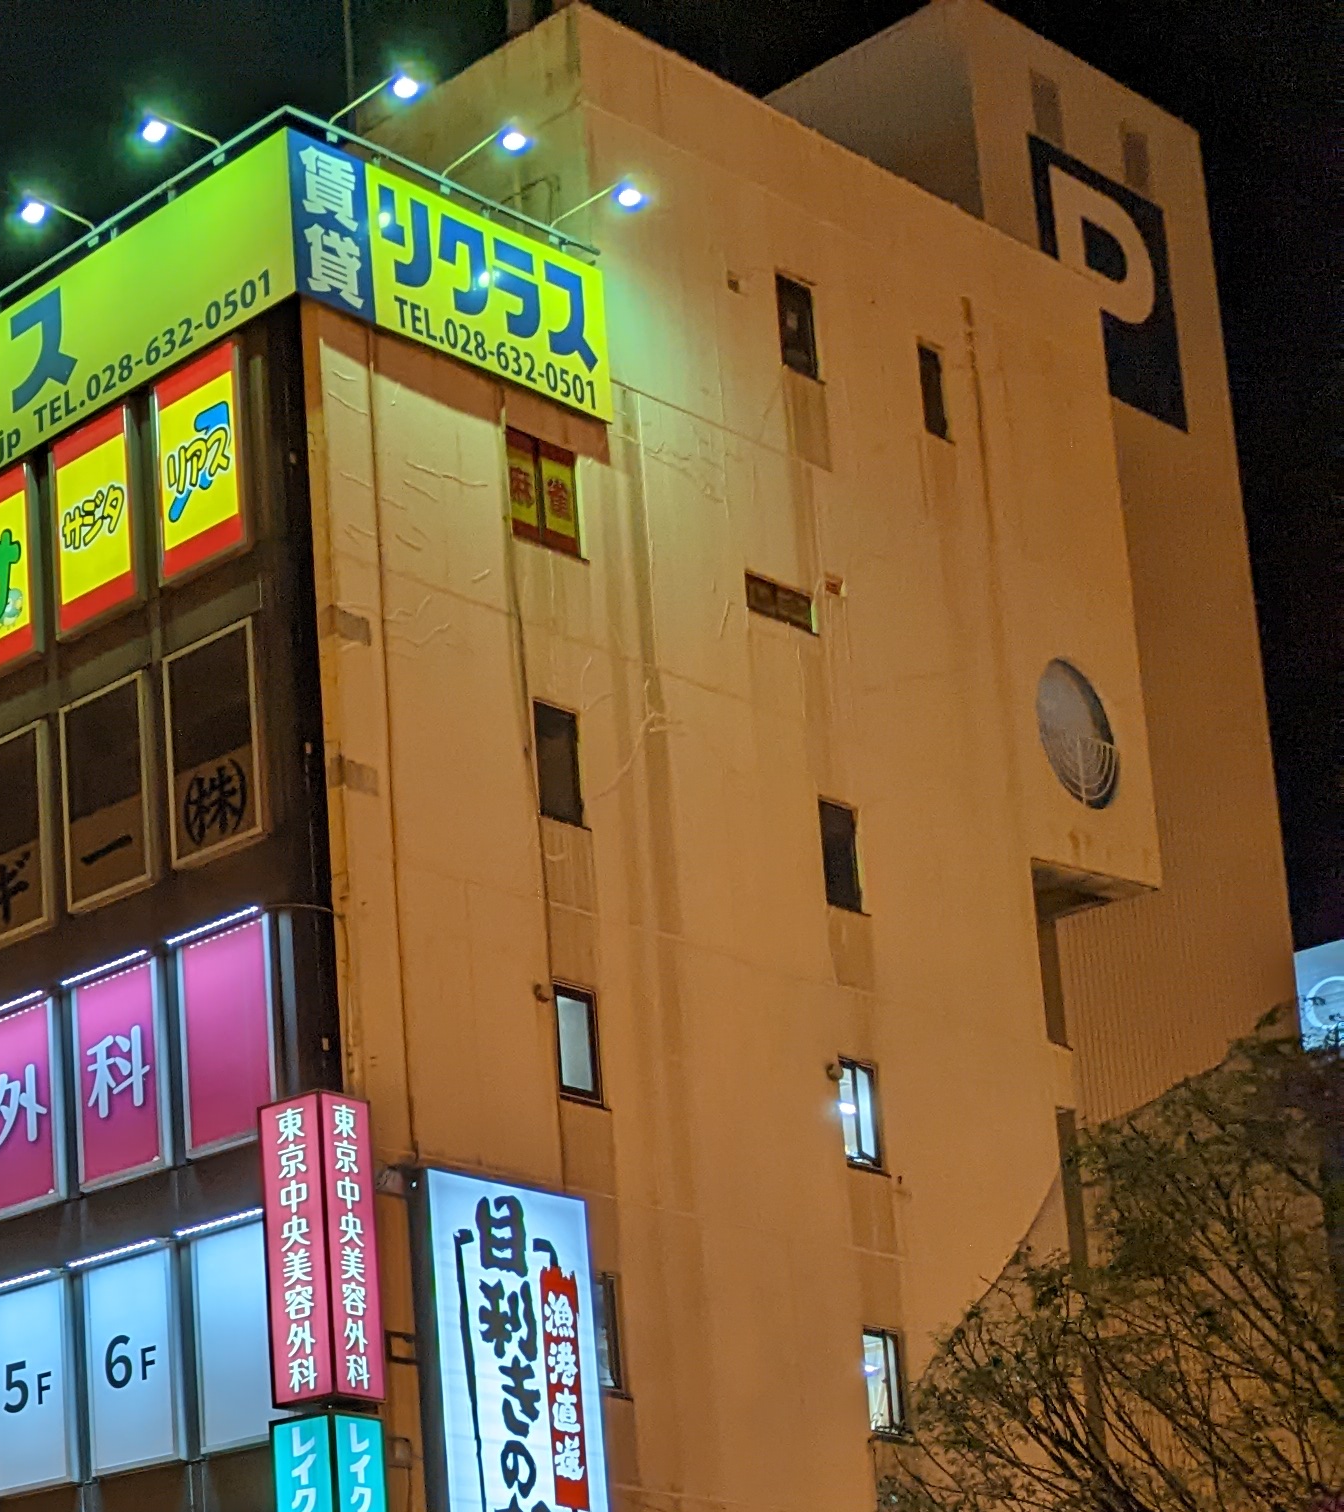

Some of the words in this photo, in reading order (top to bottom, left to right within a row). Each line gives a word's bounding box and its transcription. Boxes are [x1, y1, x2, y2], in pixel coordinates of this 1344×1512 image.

[299, 144, 365, 310] 賃貸
[377, 183, 599, 373] リクラス
[32, 268, 272, 436] TEL.028-632-0501
[394, 295, 597, 410] TEL.028-632-0501
[275, 1106, 318, 1394] 東京中央美容外科
[332, 1104, 370, 1391] 東京中央美容外科
[2, 1359, 52, 1414] 5F
[104, 1334, 157, 1390] 6F
[543, 1289, 586, 1482] 漁港直送
